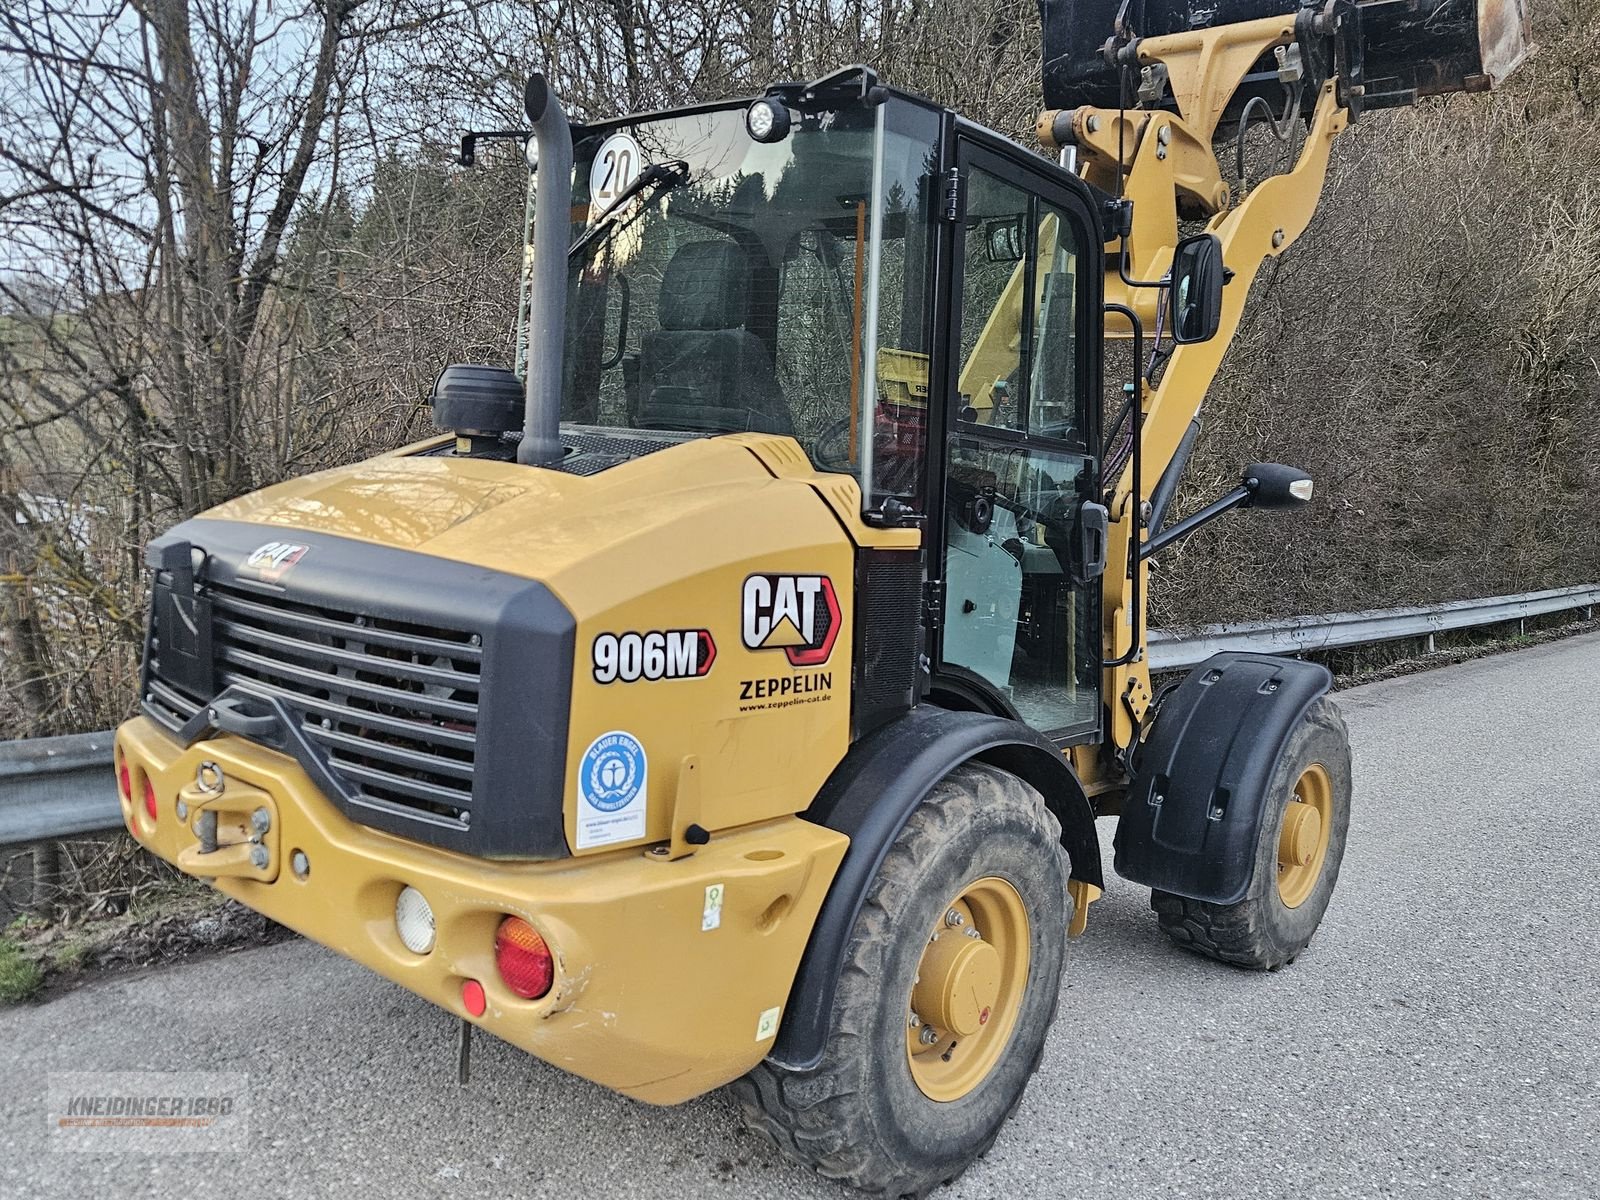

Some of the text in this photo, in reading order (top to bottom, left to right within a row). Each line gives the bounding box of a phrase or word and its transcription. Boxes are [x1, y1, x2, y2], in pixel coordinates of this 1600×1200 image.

[599, 149, 631, 199] 20
[247, 542, 303, 569] CAT
[742, 575, 822, 648] CAT
[593, 631, 699, 683] 906M
[739, 672, 832, 700] ZEPPELIN
[739, 694, 832, 712] www.zeppelin-cat.de
[588, 736, 640, 760] BLAUER ENGEL
